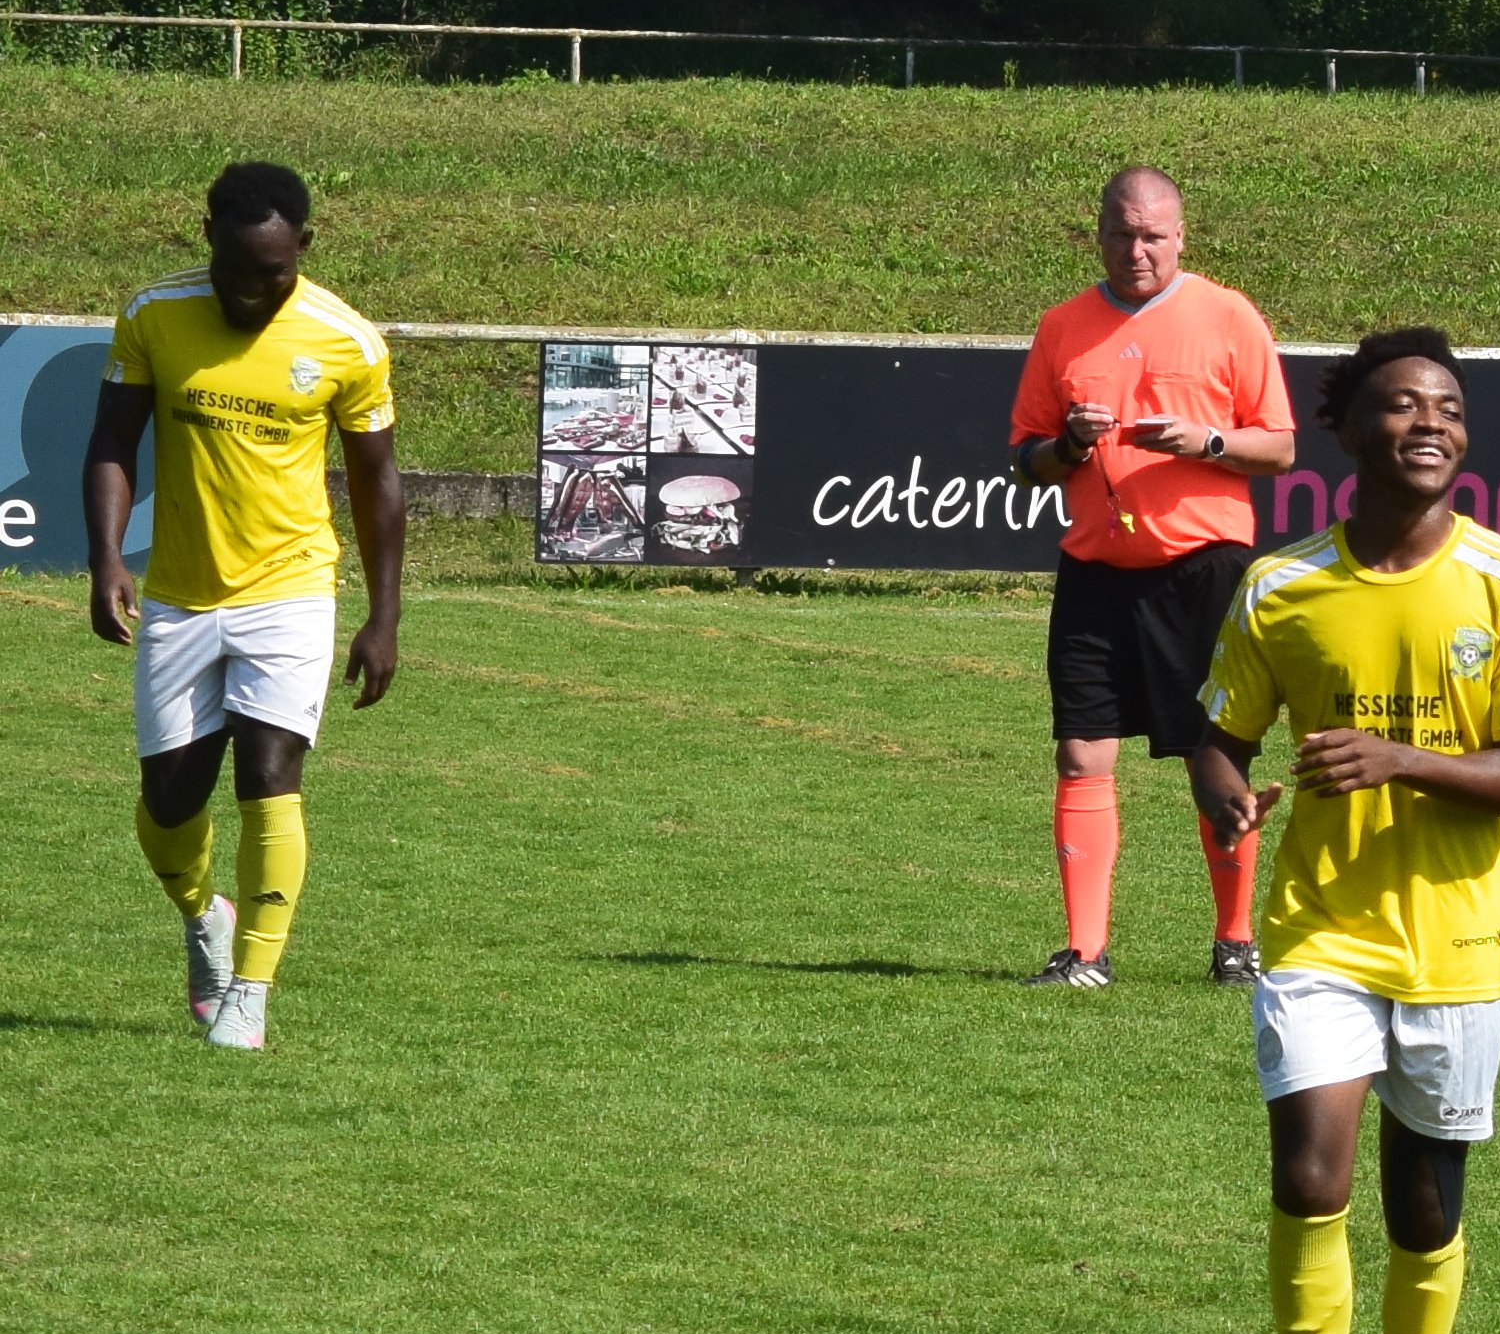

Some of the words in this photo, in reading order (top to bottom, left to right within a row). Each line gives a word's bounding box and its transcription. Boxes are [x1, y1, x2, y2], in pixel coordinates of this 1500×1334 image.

[186, 387, 276, 419] HESSISCHE
[254, 424, 290, 442] GMBH
[812, 455, 1073, 530] caterin
[1334, 693, 1444, 719] HESSISCHE
[1419, 728, 1464, 749] GMBH
